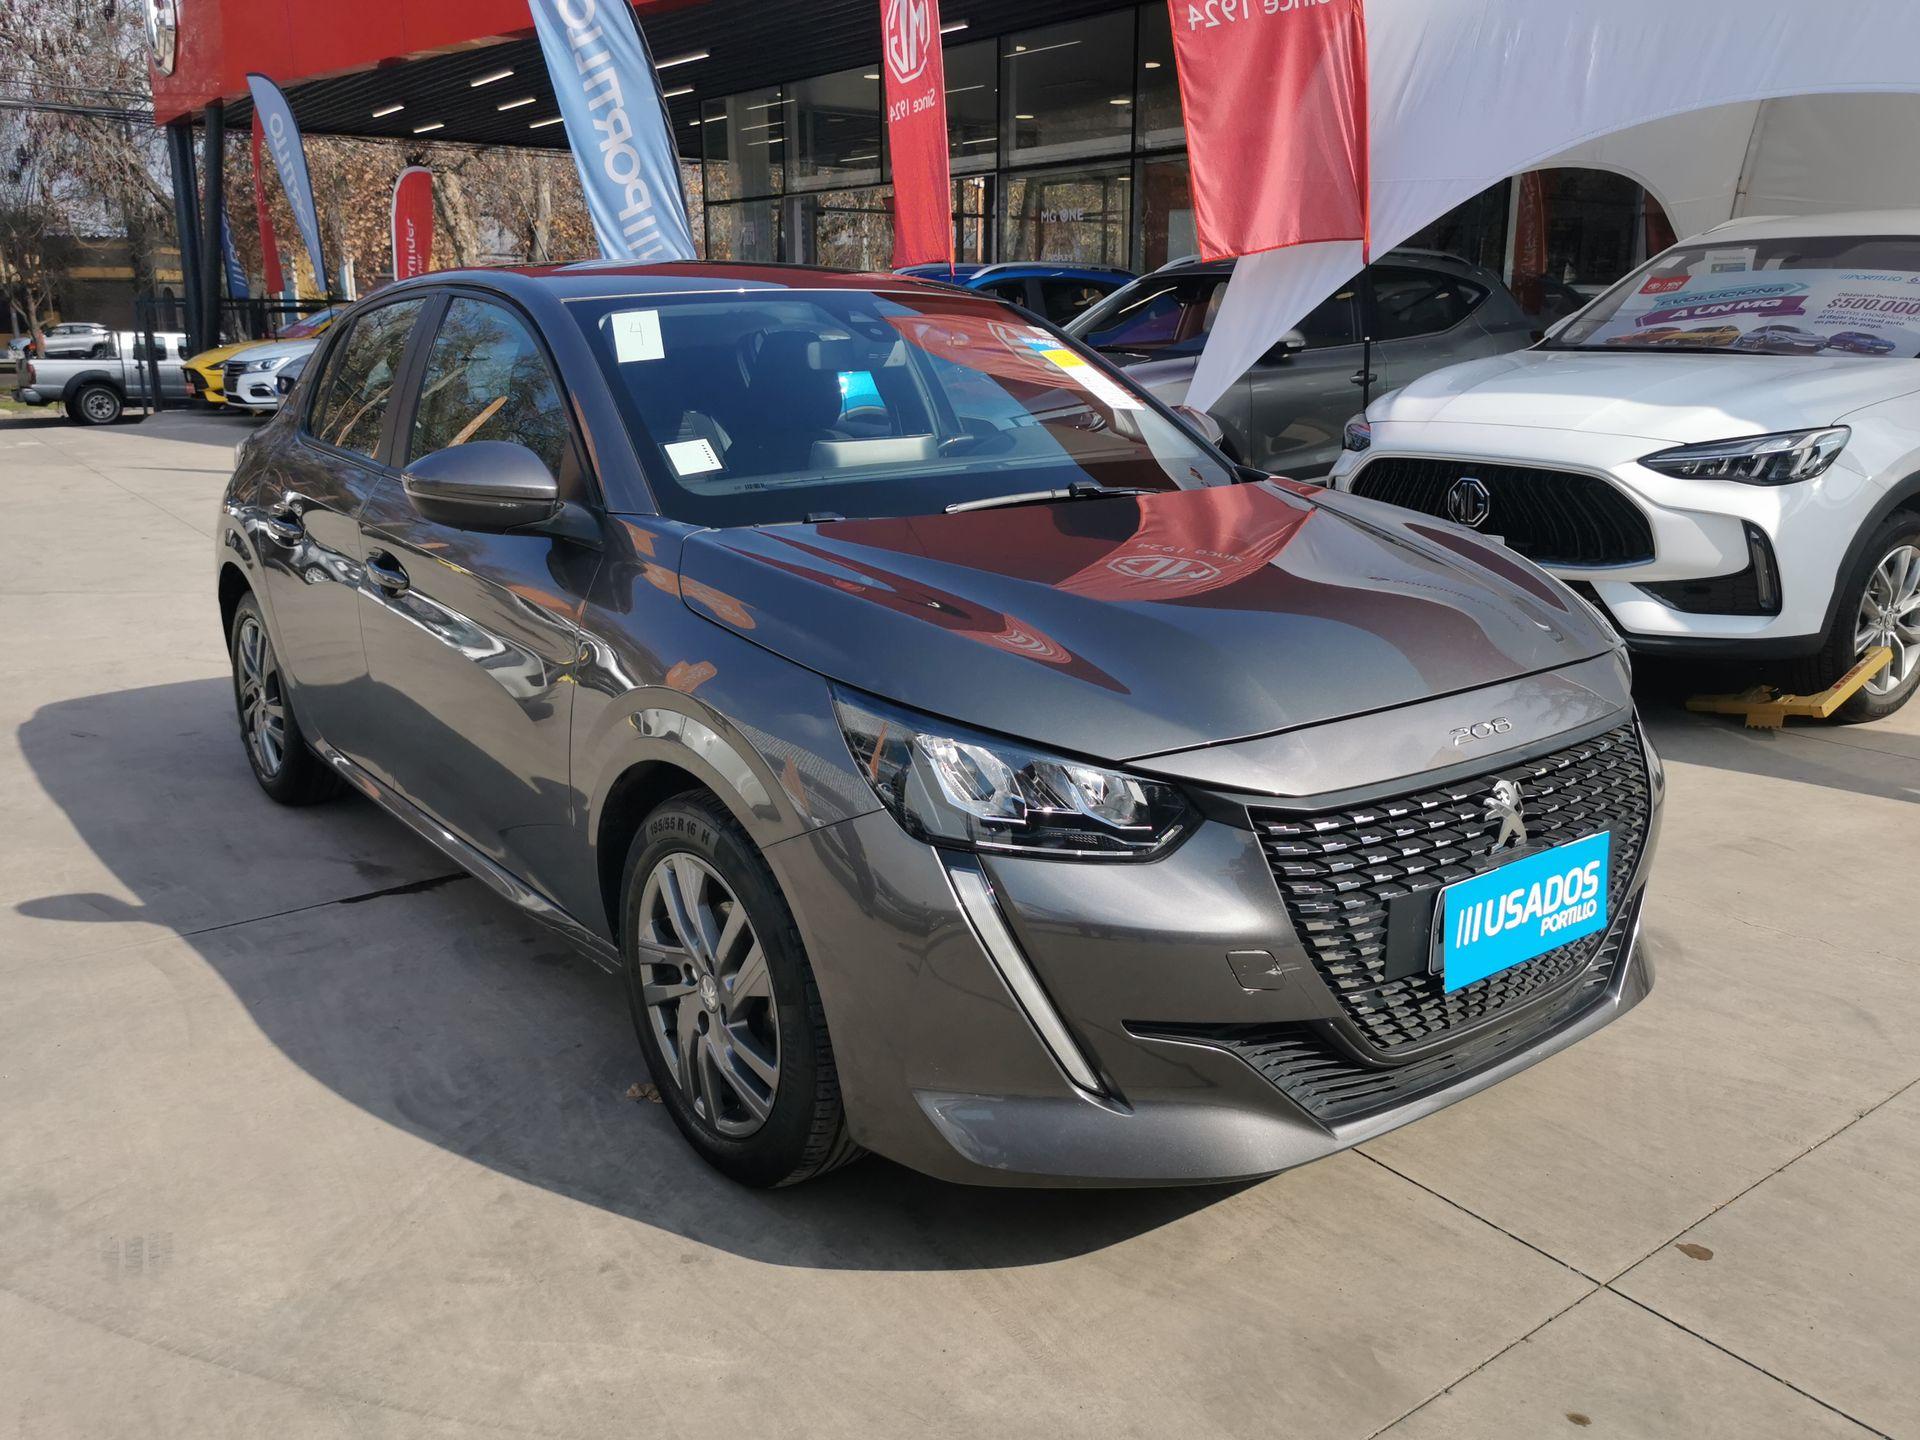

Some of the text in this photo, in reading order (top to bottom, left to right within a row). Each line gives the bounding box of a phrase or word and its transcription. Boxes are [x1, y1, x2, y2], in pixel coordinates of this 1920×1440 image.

[1041, 208, 1057, 223] MG
[1669, 299, 1784, 319] A UN MG
[629, 321, 645, 347] 4
[1450, 482, 1486, 523] MG
[1448, 716, 1512, 746] 208
[677, 817, 684, 831] R
[686, 820, 697, 838] 16
[701, 828, 710, 846] H
[1483, 859, 1602, 938] USADOS
[1539, 901, 1599, 937] PORTILLO
